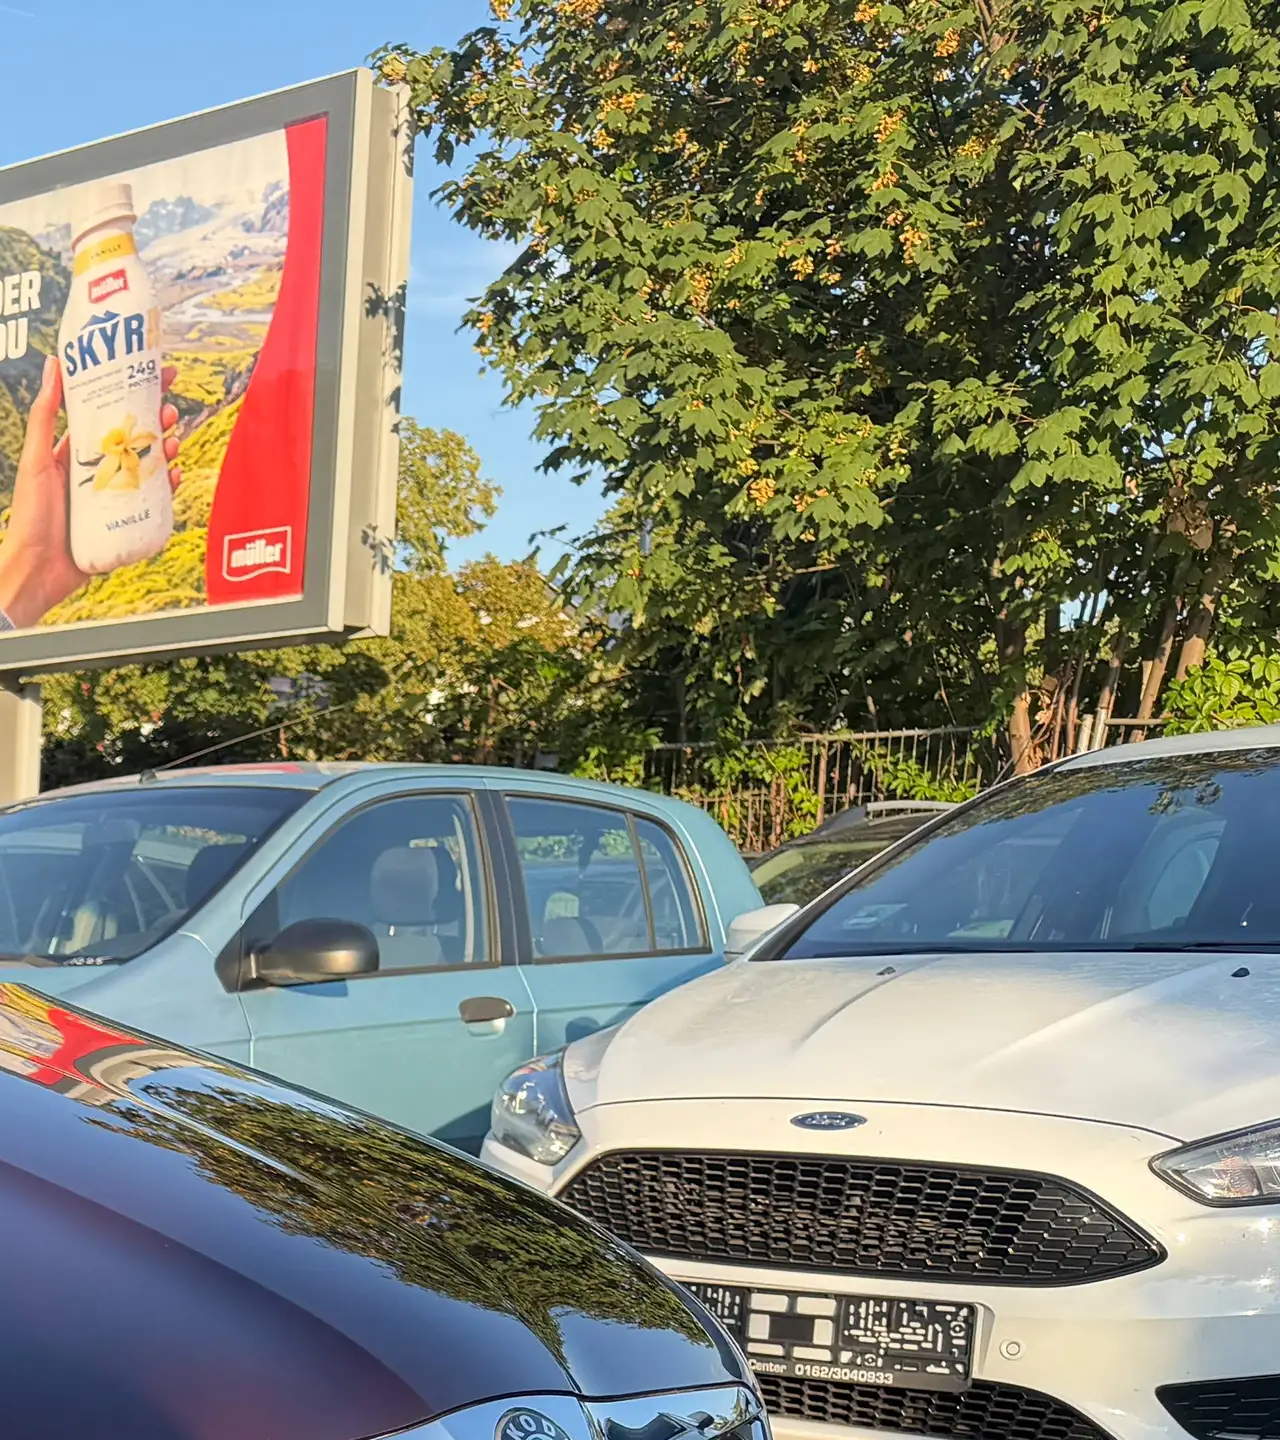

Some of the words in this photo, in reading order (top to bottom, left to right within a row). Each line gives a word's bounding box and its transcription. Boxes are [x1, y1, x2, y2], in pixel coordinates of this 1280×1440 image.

[64, 313, 144, 377] SKYR
[749, 1358, 787, 1374] Center
[795, 1364, 894, 1385] 0162/3040933
